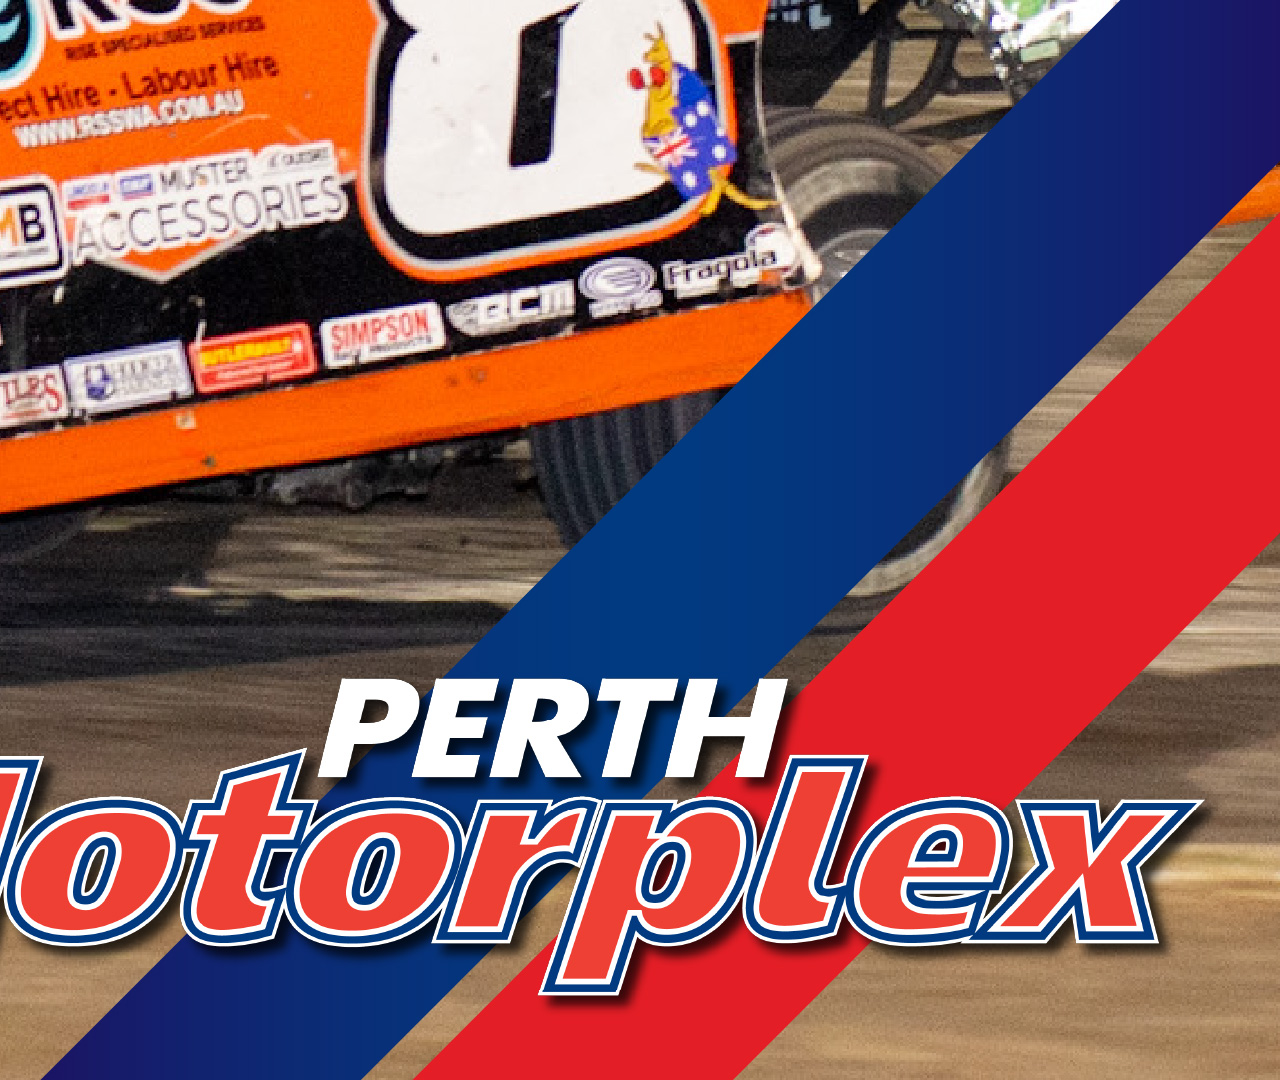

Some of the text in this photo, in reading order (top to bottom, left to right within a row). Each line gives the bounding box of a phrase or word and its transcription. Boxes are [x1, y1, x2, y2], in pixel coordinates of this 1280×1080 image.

[64, 15, 266, 61] RISE SPECIALISED SERVICES
[40, 82, 102, 115] Hire
[120, 64, 219, 99] Labour
[222, 51, 280, 81] Hire
[12, 89, 246, 149] WWW.RSSWA.COM.AU
[160, 156, 249, 193] MUSTER
[76, 174, 344, 260] ACCESSORIES
[668, 249, 778, 287] Fragola
[330, 308, 430, 351] SIMPSON
